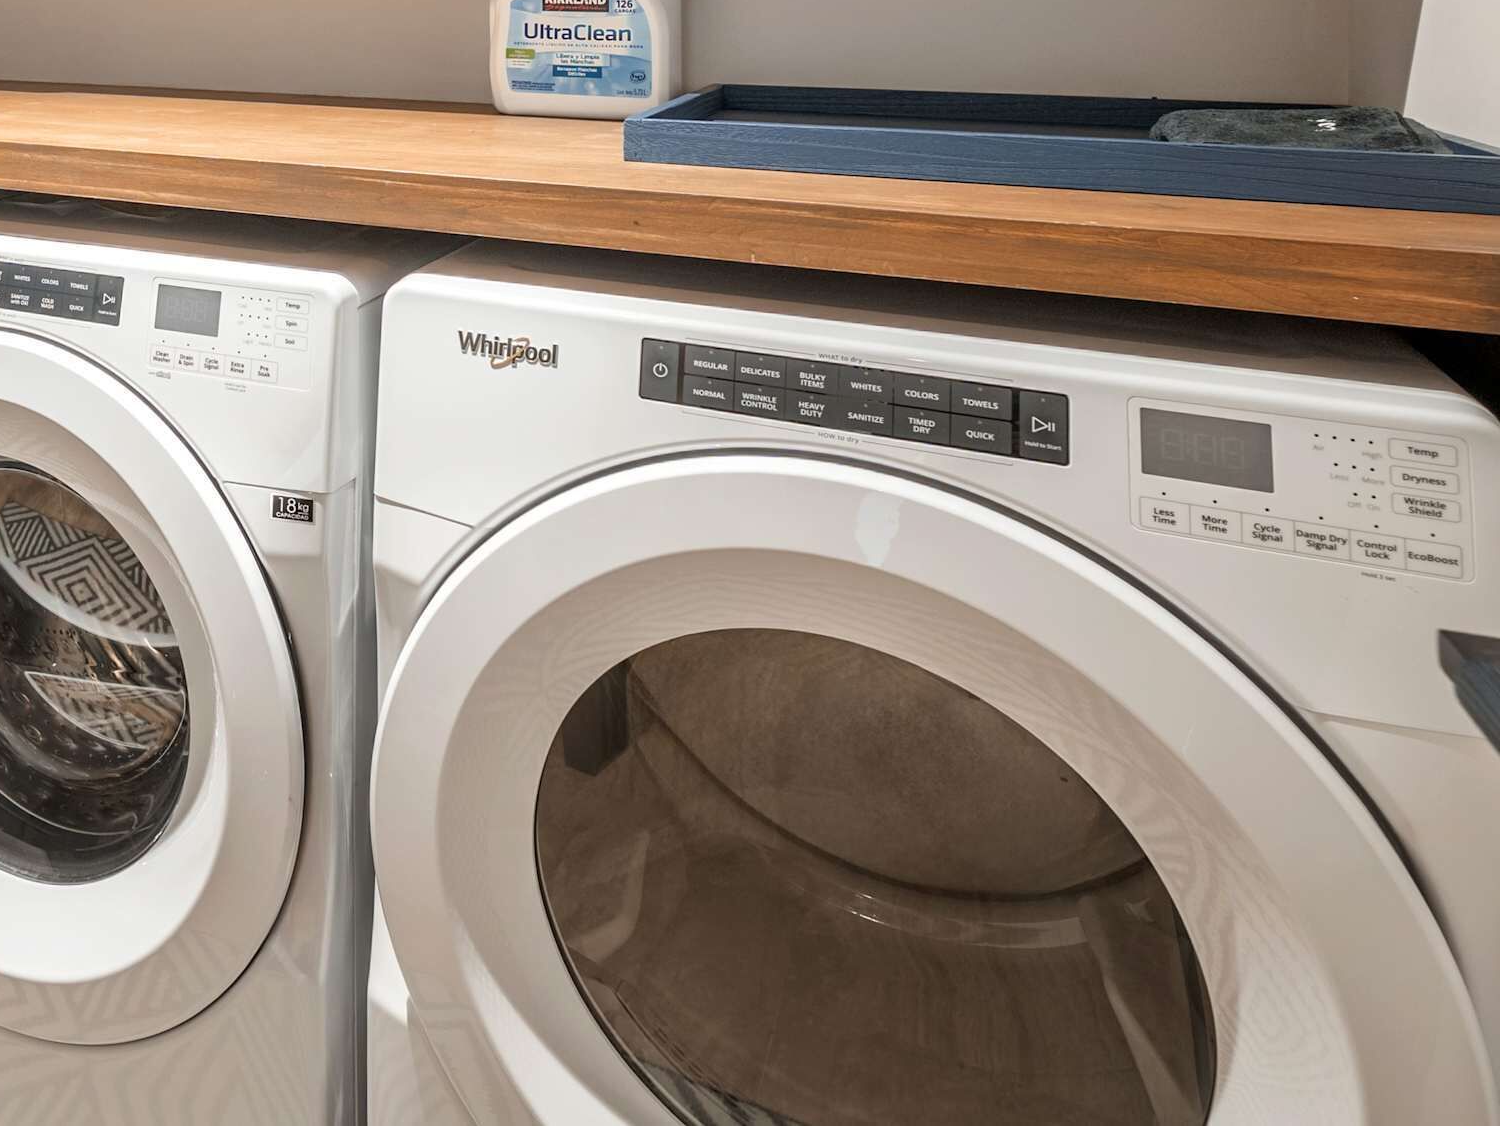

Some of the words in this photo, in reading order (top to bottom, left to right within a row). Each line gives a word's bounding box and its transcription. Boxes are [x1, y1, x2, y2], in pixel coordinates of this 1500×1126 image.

[616, 0, 633, 8] 126
[524, 23, 632, 42] UltraClean
[41, 278, 60, 286] COLORS
[70, 282, 89, 290] TOWELS
[458, 330, 559, 368] Whirlpool
[693, 360, 728, 371] REGULAR
[740, 366, 780, 378] DELICATES
[799, 372, 827, 382] BULKY
[800, 380, 825, 389] ITEMS
[850, 381, 882, 393] WHITES
[692, 388, 726, 400] NORMAL
[742, 392, 778, 404] WRINKLE
[904, 390, 940, 401] COLORS
[740, 400, 778, 411] CONTROL
[798, 401, 826, 411] HEAVY
[962, 397, 1000, 410] TOWELS
[800, 408, 822, 418] DUTY
[847, 412, 885, 424] SANITIZE
[908, 417, 936, 428] TIMED
[912, 426, 931, 435] DRY
[965, 430, 996, 442] QUICK
[1024, 440, 1039, 448] Hold
[1046, 443, 1062, 451] Start
[1407, 446, 1440, 459] Temp
[1362, 476, 1385, 485] More
[1402, 473, 1447, 486] Dryness
[278, 497, 296, 514] 18
[298, 502, 309, 513] kg
[1404, 497, 1447, 510] Wrinkle
[276, 512, 309, 520] CAPACIDAD
[1153, 507, 1176, 518] Less
[1408, 506, 1443, 518] Shield
[1152, 516, 1177, 526] Time
[1202, 515, 1228, 525] More
[1202, 523, 1228, 534] Time
[1254, 523, 1282, 534] Cycle
[1252, 531, 1284, 543] Signal
[1296, 529, 1327, 542] Damp
[1329, 534, 1348, 546] Dry
[1306, 540, 1337, 551] Signal
[1356, 539, 1398, 552] Control
[1364, 550, 1390, 560] Lock
[1408, 551, 1459, 566] EcoBoost
